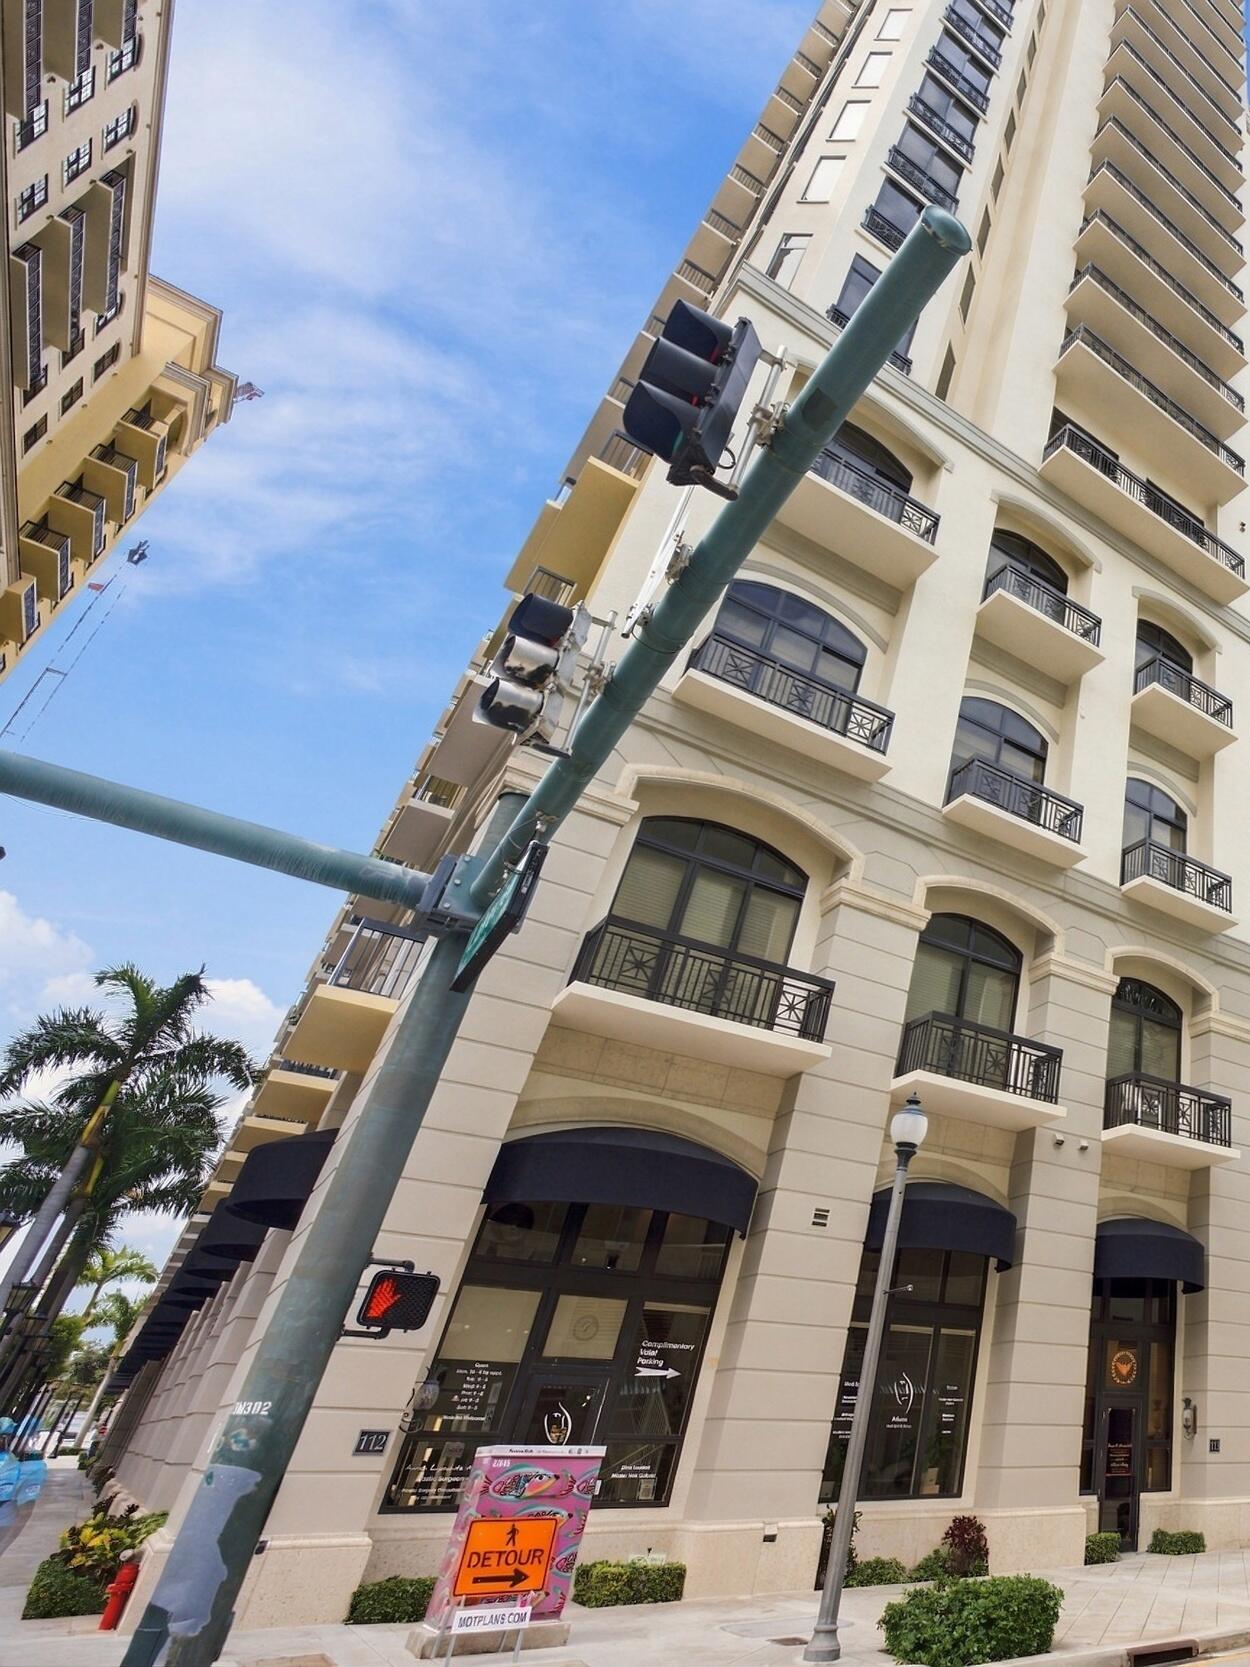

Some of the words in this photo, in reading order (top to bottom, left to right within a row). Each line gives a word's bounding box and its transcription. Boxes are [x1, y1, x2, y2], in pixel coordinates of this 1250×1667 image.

[641, 1340, 695, 1351] Complimentary
[640, 1349, 658, 1357] Valet
[637, 1357, 664, 1367] Parking
[359, 1434, 387, 1450] 112
[466, 1548, 544, 1569] DETOUR
